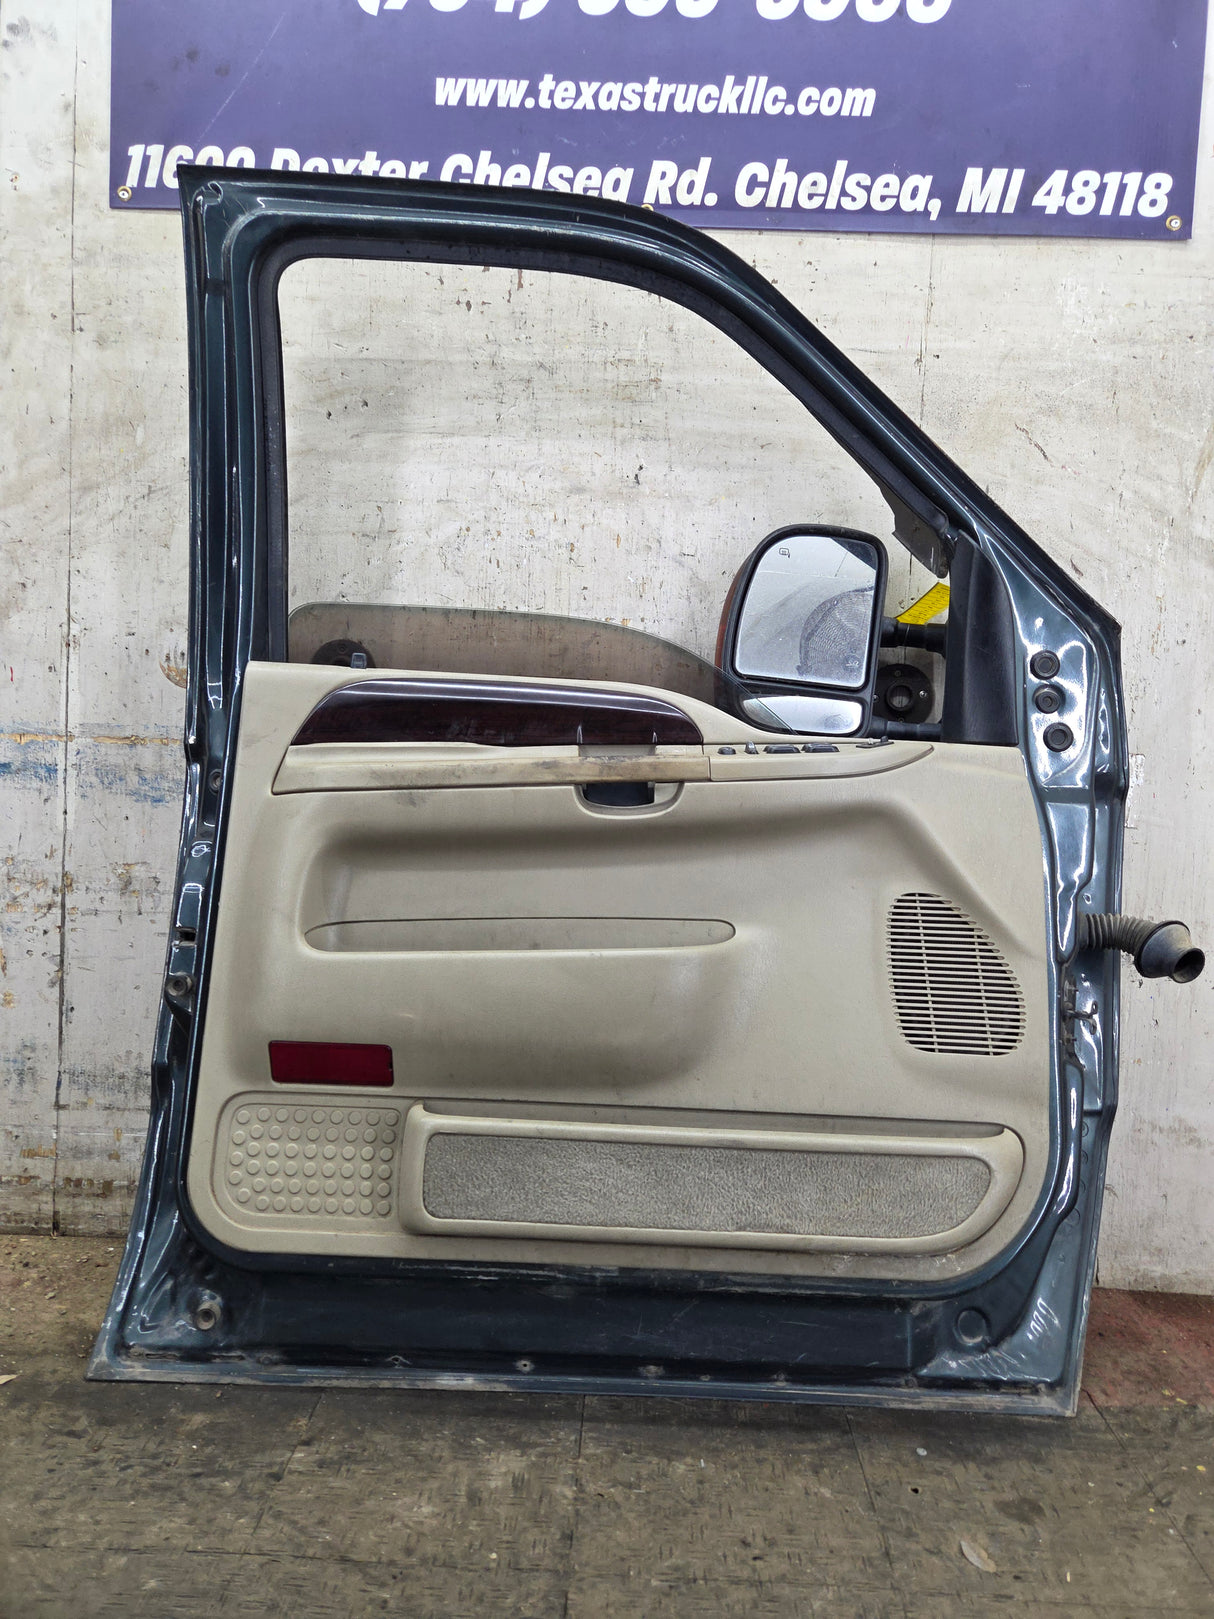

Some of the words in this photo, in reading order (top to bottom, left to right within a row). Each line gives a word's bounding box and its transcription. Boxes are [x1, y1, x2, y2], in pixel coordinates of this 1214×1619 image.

[435, 74, 877, 117] www.texastruckllc.com
[643, 157, 718, 207] Rd.
[735, 159, 943, 221] Chelsea,
[956, 168, 1025, 214] MI
[1032, 169, 1174, 218] 48118
